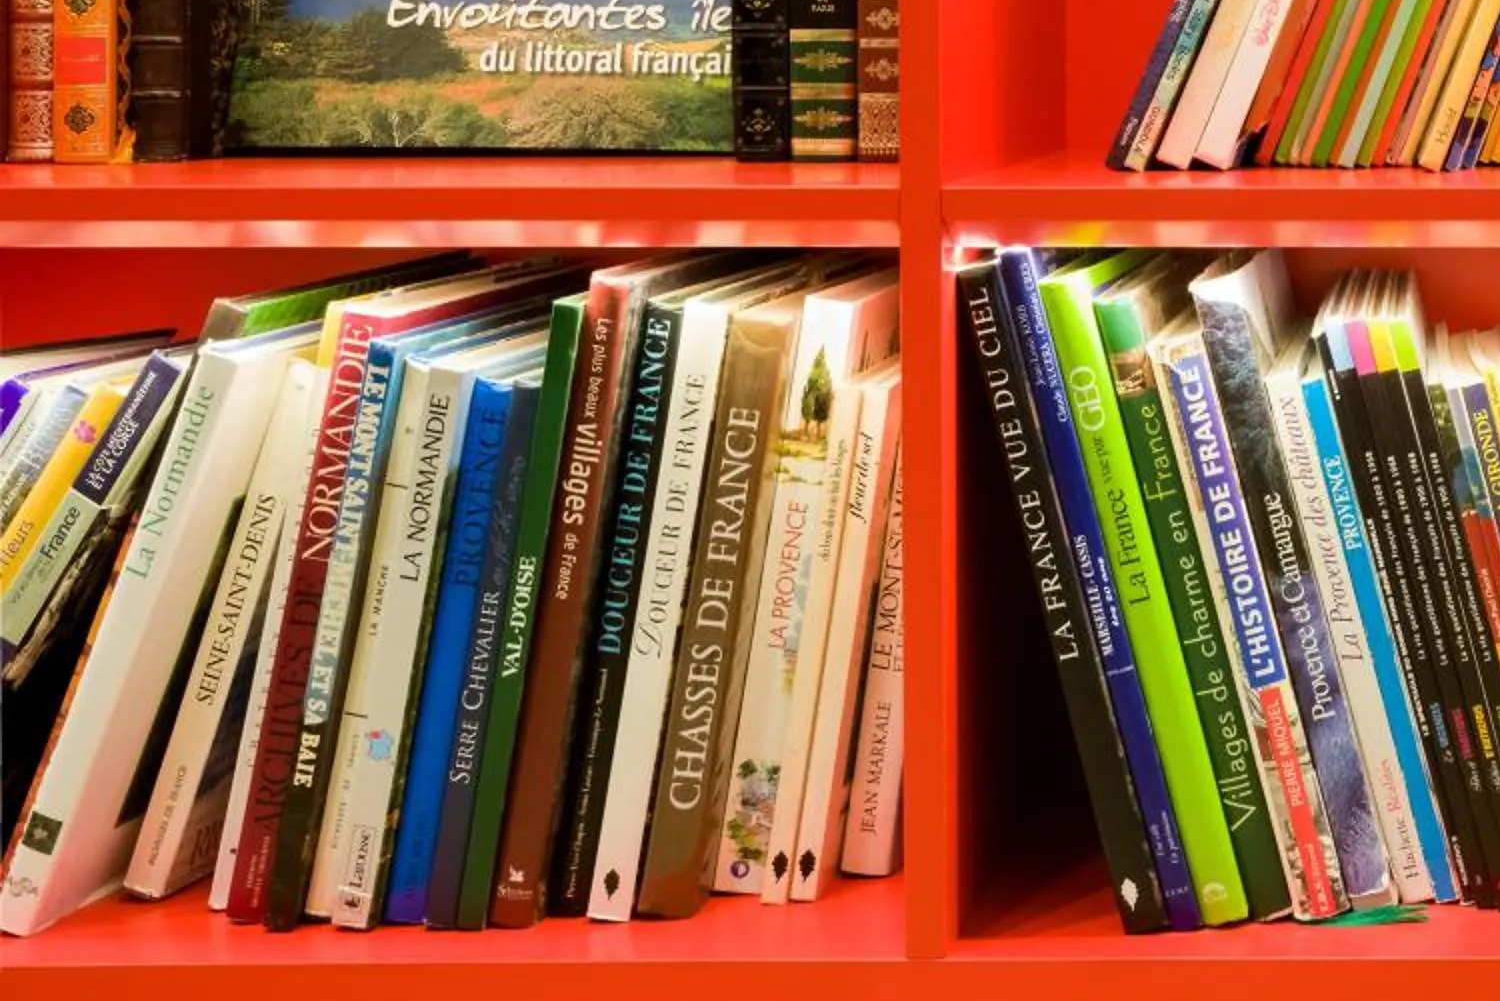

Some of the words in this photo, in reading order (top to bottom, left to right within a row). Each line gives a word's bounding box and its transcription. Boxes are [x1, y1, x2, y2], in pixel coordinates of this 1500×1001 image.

[479, 41, 515, 73] du
[524, 41, 623, 74] littoral
[631, 41, 732, 82] françai
[593, 316, 613, 340] Les
[964, 285, 1002, 358] CIEL
[361, 362, 391, 399] LE
[587, 343, 609, 372] plus
[626, 316, 673, 445] FRANCE
[582, 375, 604, 417] beaux
[985, 366, 1016, 410] DU
[1065, 362, 1108, 434] GEO
[100, 456, 116, 474] LA
[110, 417, 140, 458] CORSE
[296, 321, 377, 566] NORMANDIE
[346, 399, 384, 476] MONT
[667, 373, 709, 471] FRANCE
[855, 431, 875, 454] sel
[1089, 434, 1109, 457] par
[1177, 363, 1225, 477] FRANCE
[1271, 393, 1319, 493] châteaux
[135, 381, 220, 536] Normandie
[401, 391, 454, 543] NORMANDIE
[557, 419, 604, 525] villages
[621, 451, 651, 495] DE
[851, 458, 871, 478] de
[998, 416, 1034, 483] VUE
[1097, 457, 1114, 483] vue
[1128, 401, 1177, 500] France
[451, 406, 509, 588] PROVENCE
[663, 479, 689, 514] DE
[704, 405, 764, 566] FRANCE
[843, 476, 874, 523] fleur
[1207, 482, 1237, 523] DE
[1298, 494, 1328, 531] des
[1322, 453, 1363, 551] PROVENCE
[38, 503, 82, 560] France
[563, 531, 580, 550] de
[1016, 488, 1067, 612] FRANCE
[1100, 486, 1140, 568] France
[1166, 509, 1189, 544] en
[1257, 489, 1310, 606] Camargue
[122, 542, 156, 580] La
[398, 549, 423, 582] LA
[554, 552, 577, 600] France
[594, 502, 645, 655] DOUCEUR
[766, 499, 812, 621] PROVENCE
[1121, 571, 1151, 605] La
[1308, 530, 1354, 626] Provence
[191, 491, 281, 708] SEINE-SAINT-DENIS
[368, 564, 392, 615] MANCHE
[497, 554, 538, 680] VAL-D'OISE
[628, 522, 685, 660] DOUCEUR
[694, 576, 735, 632] DE
[1166, 551, 1219, 661] charme
[1218, 526, 1276, 678] L'HISTOIRE
[1291, 603, 1313, 624] et
[365, 622, 379, 637] LA
[459, 588, 505, 712] CHEVALIER
[765, 624, 790, 651] LA
[869, 642, 893, 672] LE
[1049, 620, 1079, 662] LA
[1334, 629, 1364, 664] La
[309, 660, 334, 692] ET
[1192, 666, 1229, 705] de
[1290, 624, 1335, 721] Provence
[304, 691, 328, 722] SA
[665, 641, 726, 813] CHASSES
[1265, 698, 1291, 756] MIQUEL
[293, 725, 323, 782] BAIE
[446, 718, 480, 784] SERRE
[865, 699, 893, 785] MARKALE
[1204, 709, 1262, 830] Villages
[1279, 758, 1304, 808] PIERRE
[859, 790, 882, 835] JEAN
